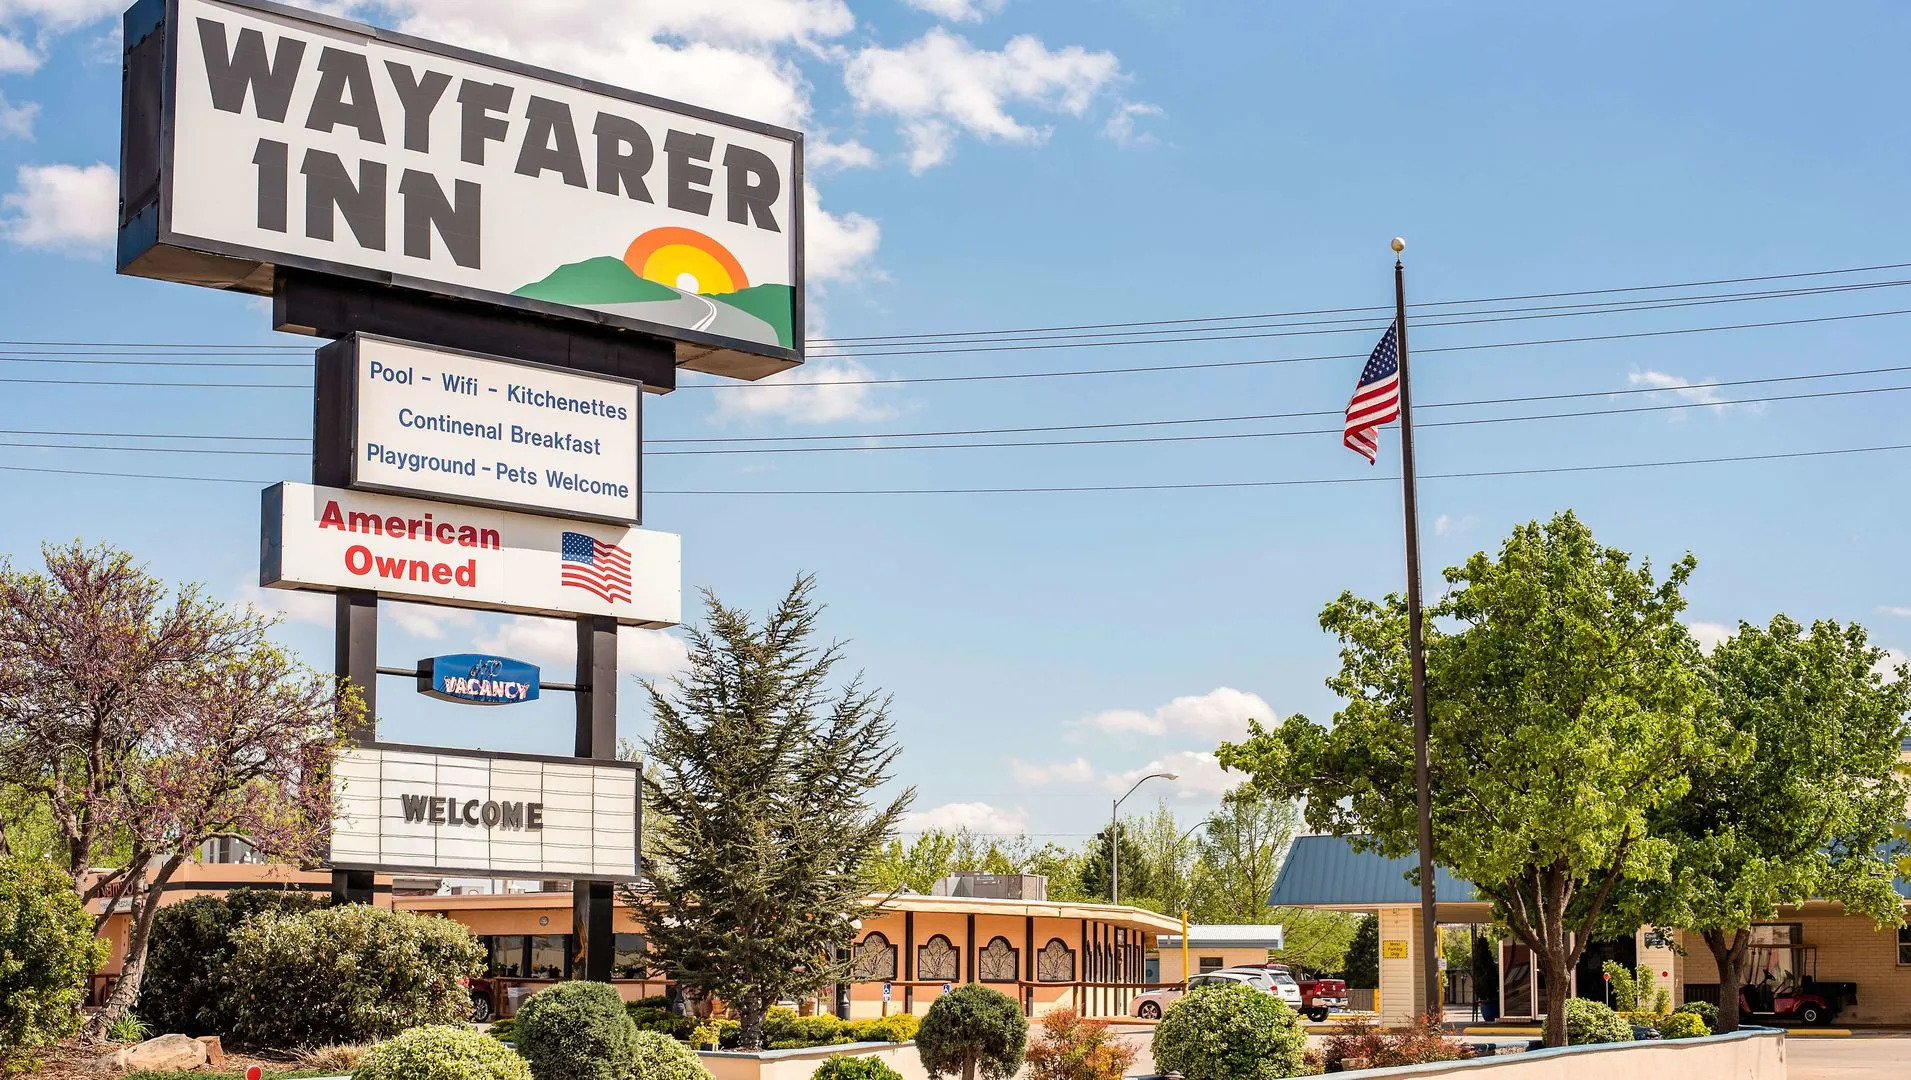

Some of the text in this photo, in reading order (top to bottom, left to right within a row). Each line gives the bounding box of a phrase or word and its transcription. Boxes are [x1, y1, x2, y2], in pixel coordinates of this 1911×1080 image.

[195, 17, 782, 233] WAYFARER
[252, 137, 482, 270] INN
[369, 361, 413, 385] Pool
[442, 372, 478, 397] Wifi
[507, 384, 628, 421] Kitchenettes
[398, 408, 601, 455] Continenal Breakfast
[367, 443, 476, 477] Playground
[496, 462, 538, 486] Pets
[546, 469, 629, 499] Welcome
[318, 500, 500, 550] American
[344, 545, 476, 588] Owned
[444, 676, 530, 700] VACANCY
[401, 794, 544, 831] WELCOME
